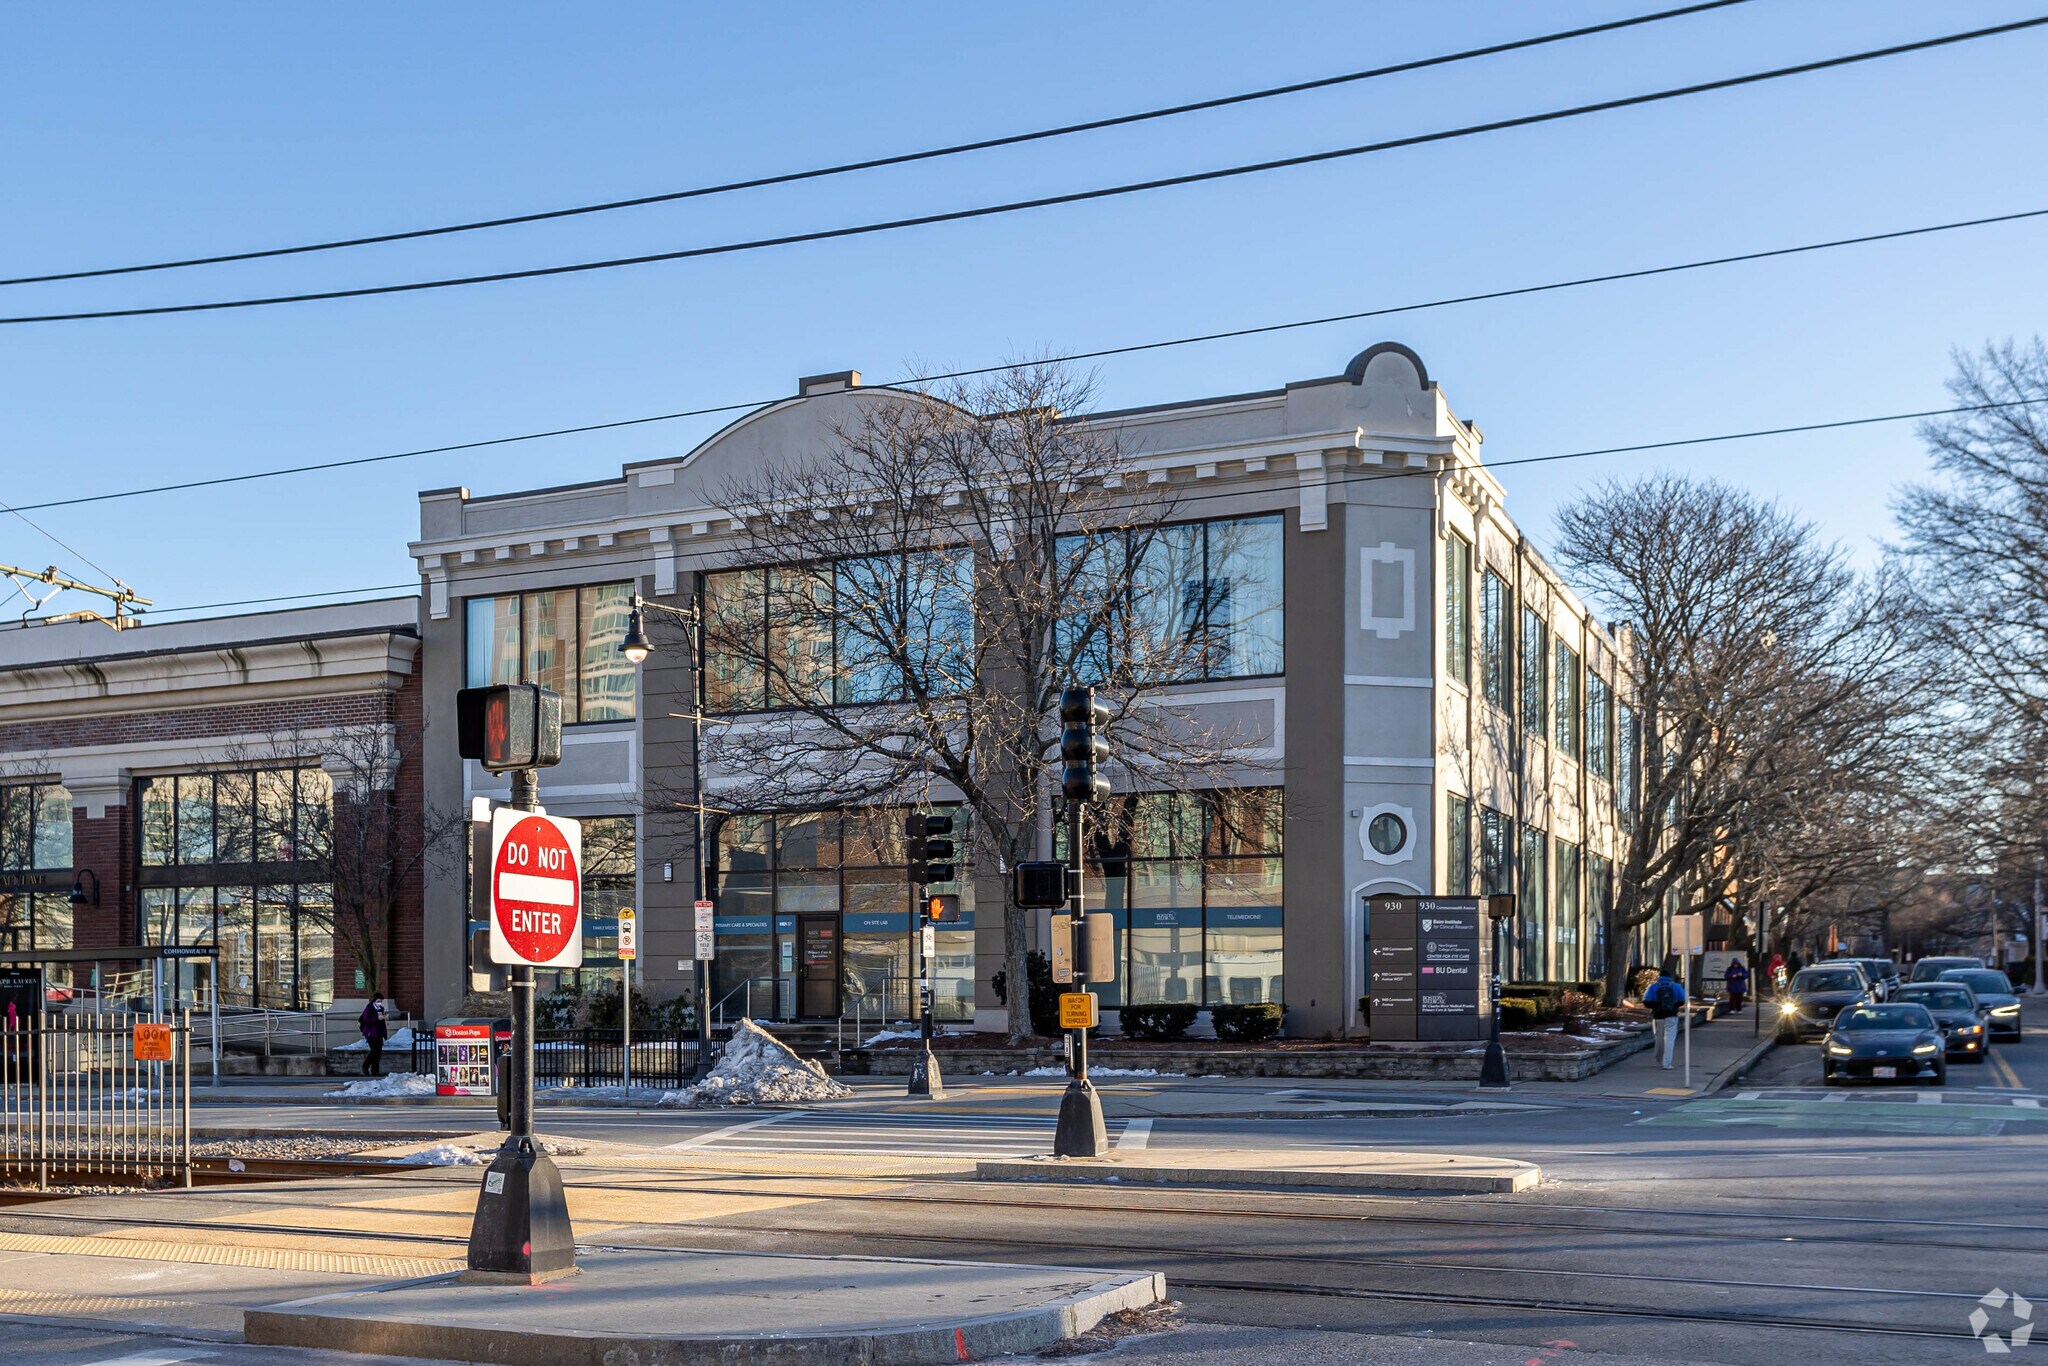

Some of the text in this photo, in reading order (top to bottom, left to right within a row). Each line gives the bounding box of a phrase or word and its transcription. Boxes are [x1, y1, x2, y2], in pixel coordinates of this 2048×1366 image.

[508, 842, 567, 871] DO NOT
[1384, 902, 1402, 911] 930
[1420, 902, 1435, 910] 930
[512, 910, 561, 935] ENTER
[137, 1028, 167, 1041] LOOK
